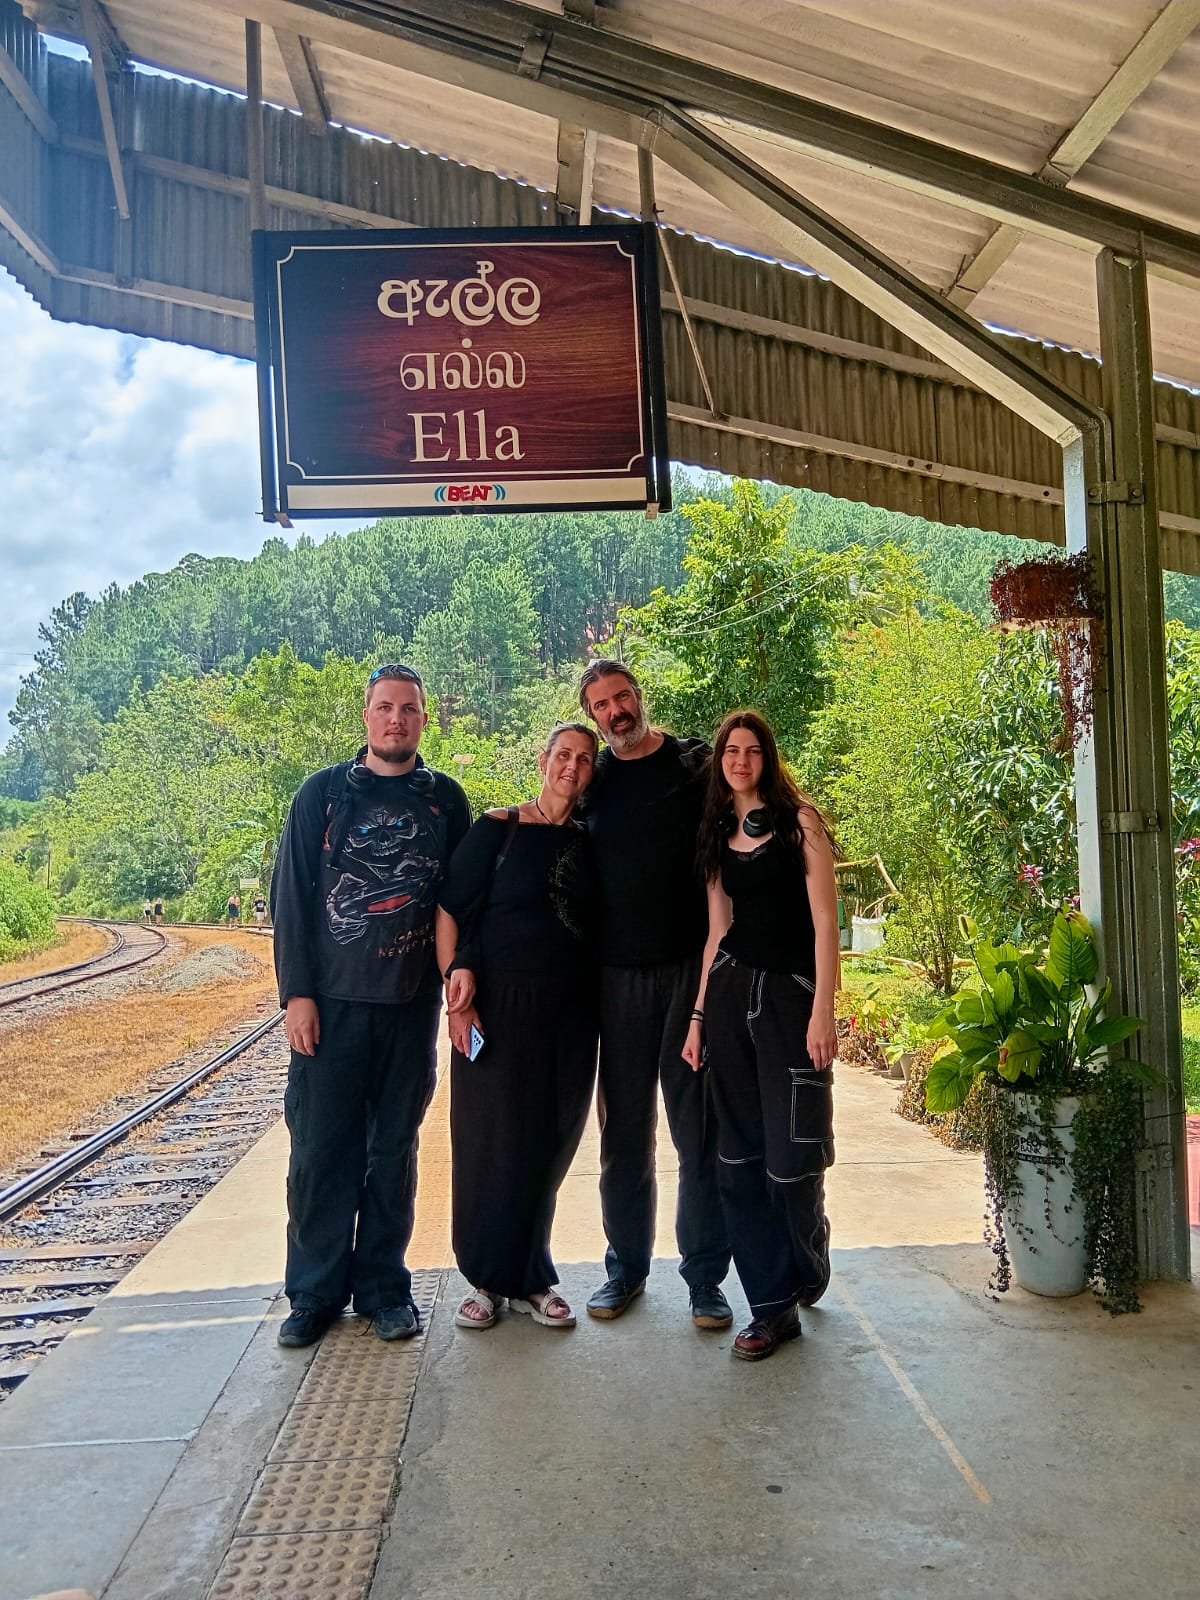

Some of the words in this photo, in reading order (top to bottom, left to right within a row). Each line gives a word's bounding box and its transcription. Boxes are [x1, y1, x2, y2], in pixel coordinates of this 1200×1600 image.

[377, 260, 541, 326] ඇල්ල
[400, 338, 526, 390] எல்ல
[408, 409, 526, 463] Ella
[448, 485, 493, 502] BEAT
